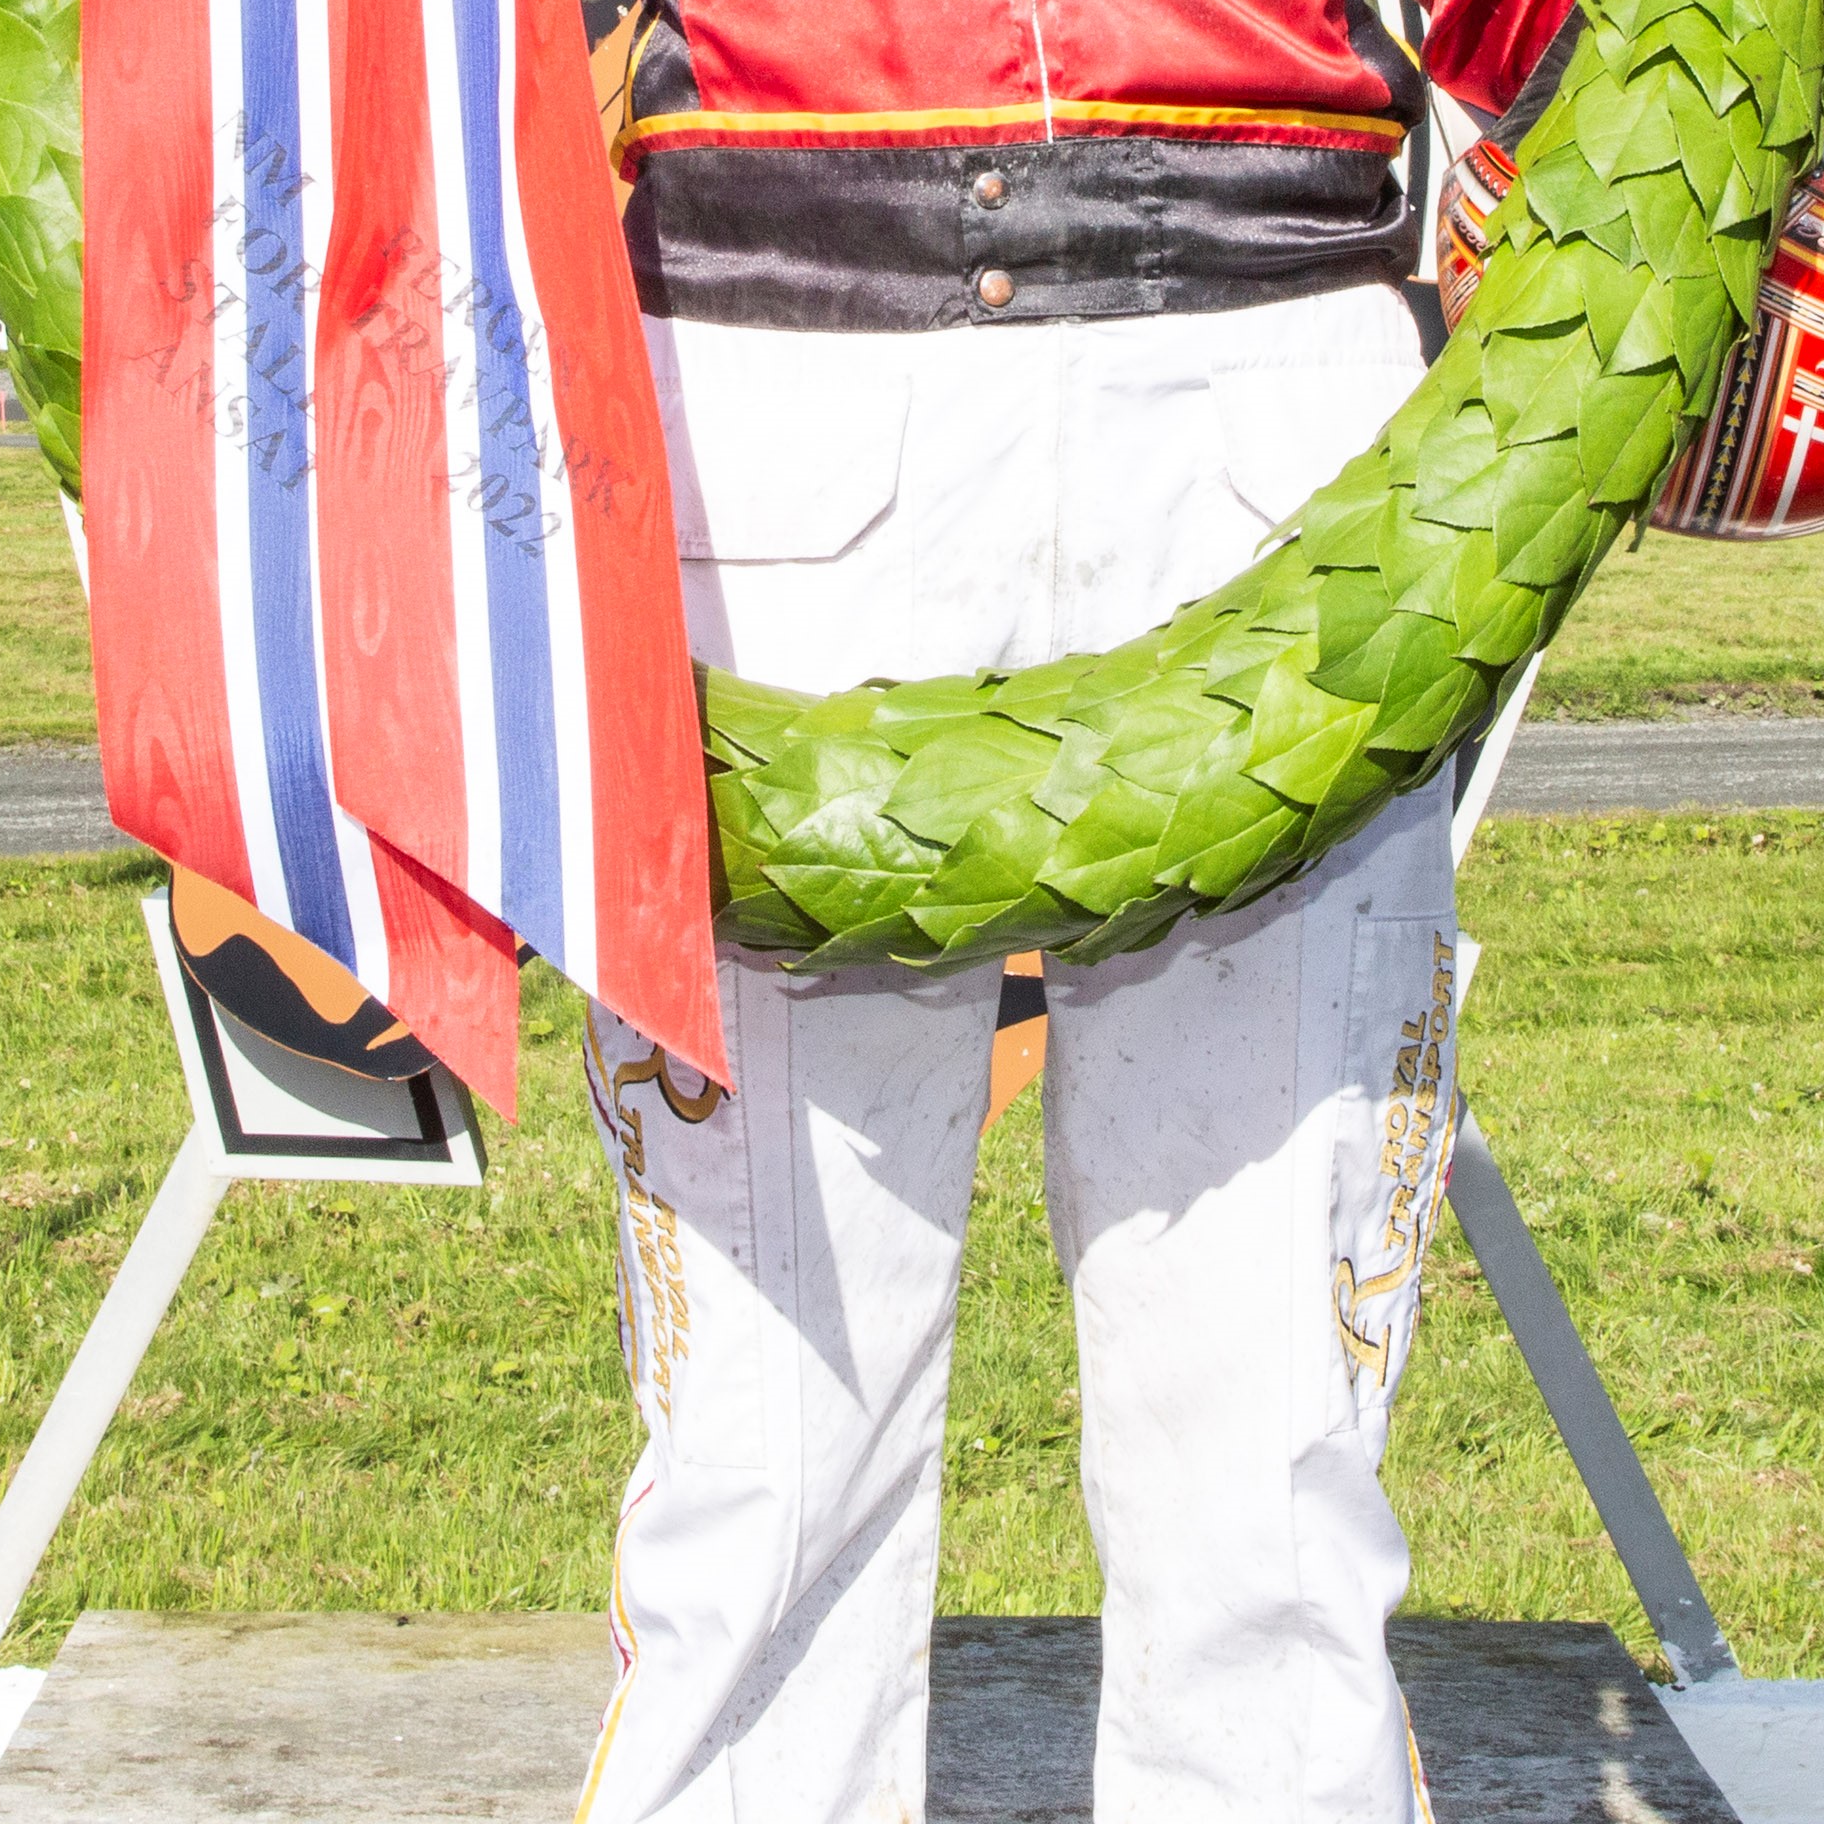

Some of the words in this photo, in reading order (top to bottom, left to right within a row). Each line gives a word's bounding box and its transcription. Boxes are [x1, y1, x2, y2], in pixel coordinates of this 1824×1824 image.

[213, 108, 317, 208] NM
[202, 195, 322, 316] FOR
[350, 302, 636, 519] TRAVPARK
[430, 450, 563, 560] 2022
[1379, 1010, 1427, 1179] ROYAL
[1383, 929, 1456, 1252] TRANSPORT
[618, 1103, 673, 1434] TRANSPORT
[651, 1191, 691, 1361] ROYAL
